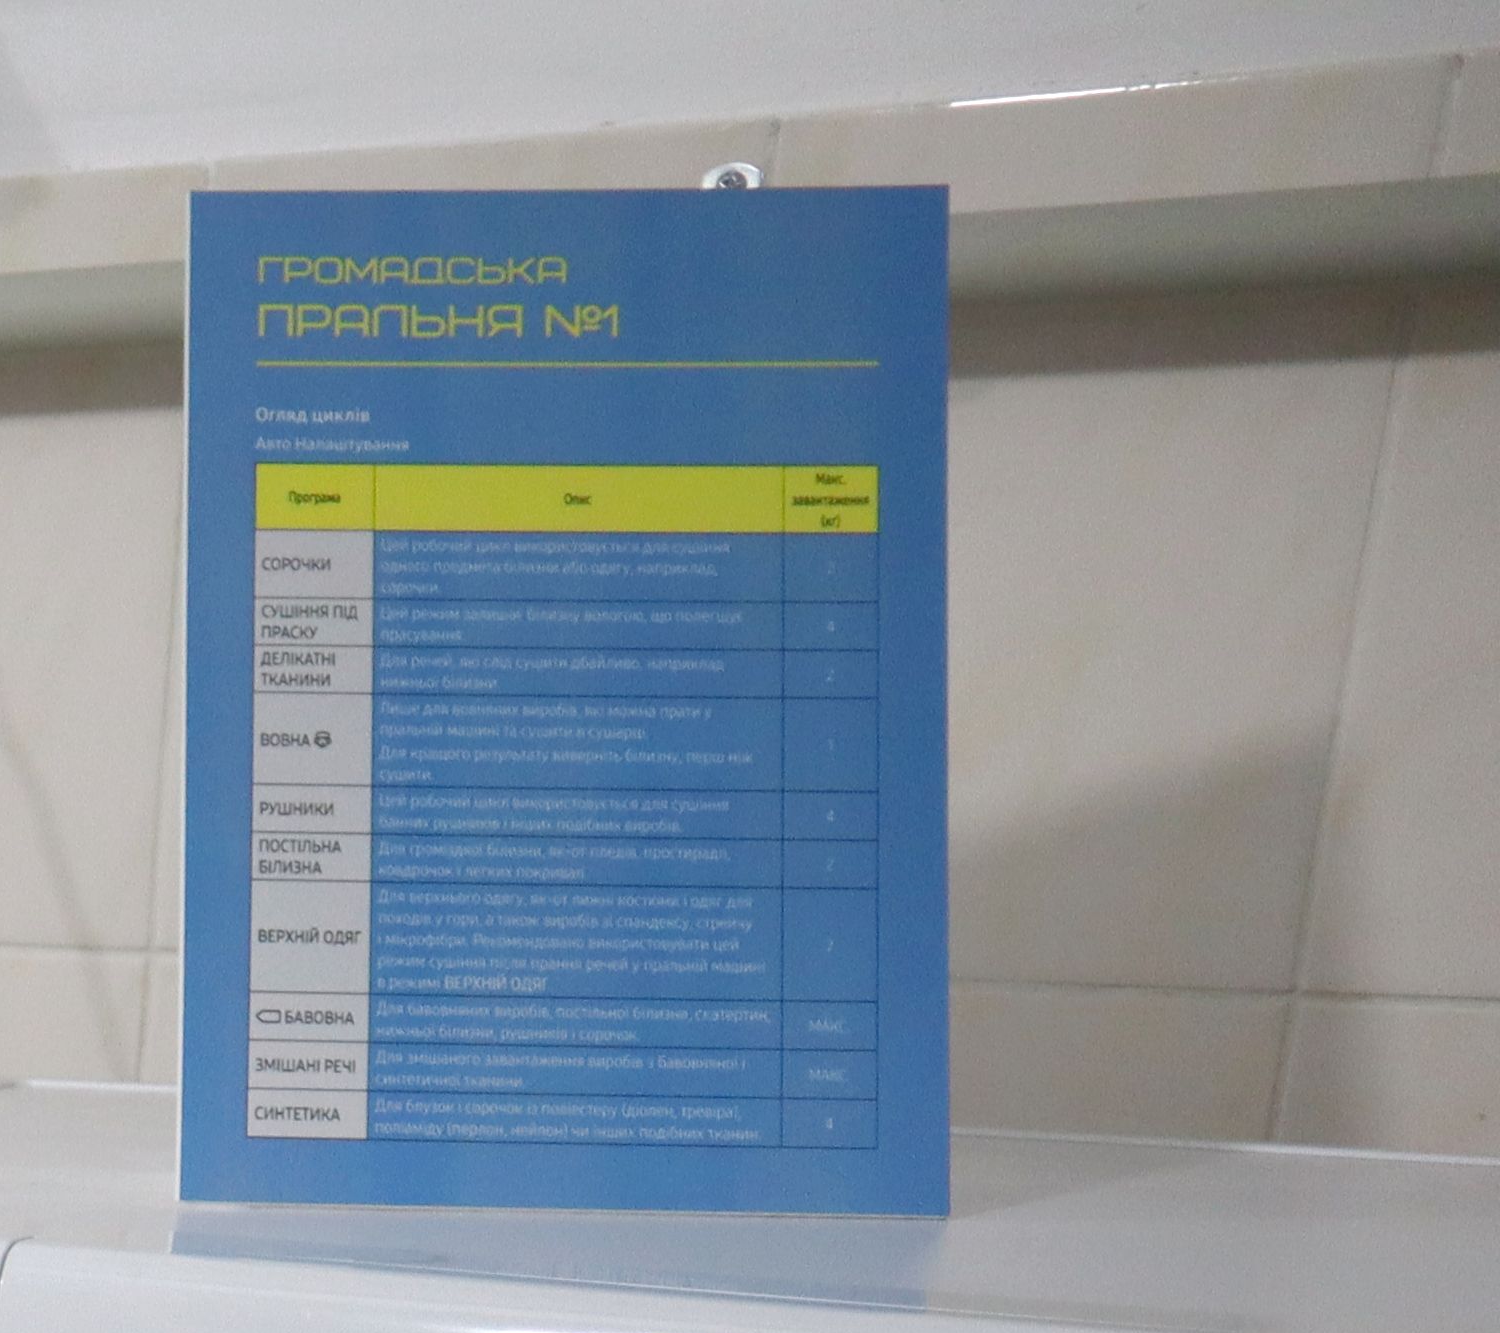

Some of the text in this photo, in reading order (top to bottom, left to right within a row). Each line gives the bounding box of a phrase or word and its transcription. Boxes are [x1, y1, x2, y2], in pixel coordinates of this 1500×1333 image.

[257, 254, 568, 286] ГРОМАДСЬКА
[257, 302, 620, 340] ПРАЛЬНЯ №1
[255, 406, 370, 424] Огляд циклів
[261, 556, 331, 571] СОРОЧКИ
[261, 604, 358, 620] СУШІННЯ ПІД
[261, 625, 318, 640] ПРАСКУ
[260, 651, 336, 667] ДЕЛІКАТНІ
[261, 672, 331, 687] ТКАНИНИ
[260, 732, 311, 748] ВОВНА
[259, 801, 334, 817] РУШНИКИ
[259, 838, 342, 854] ПОСТІЛЬНА
[259, 860, 322, 874] БІЛИЗНА
[258, 927, 362, 945] ВЕРХНІЙ ОДЯГ
[284, 1010, 355, 1026] БАВОВНА
[255, 1057, 356, 1073] ЗМІШАНІ РЕЧІ
[254, 1105, 341, 1121] СИНТЕТИКА
